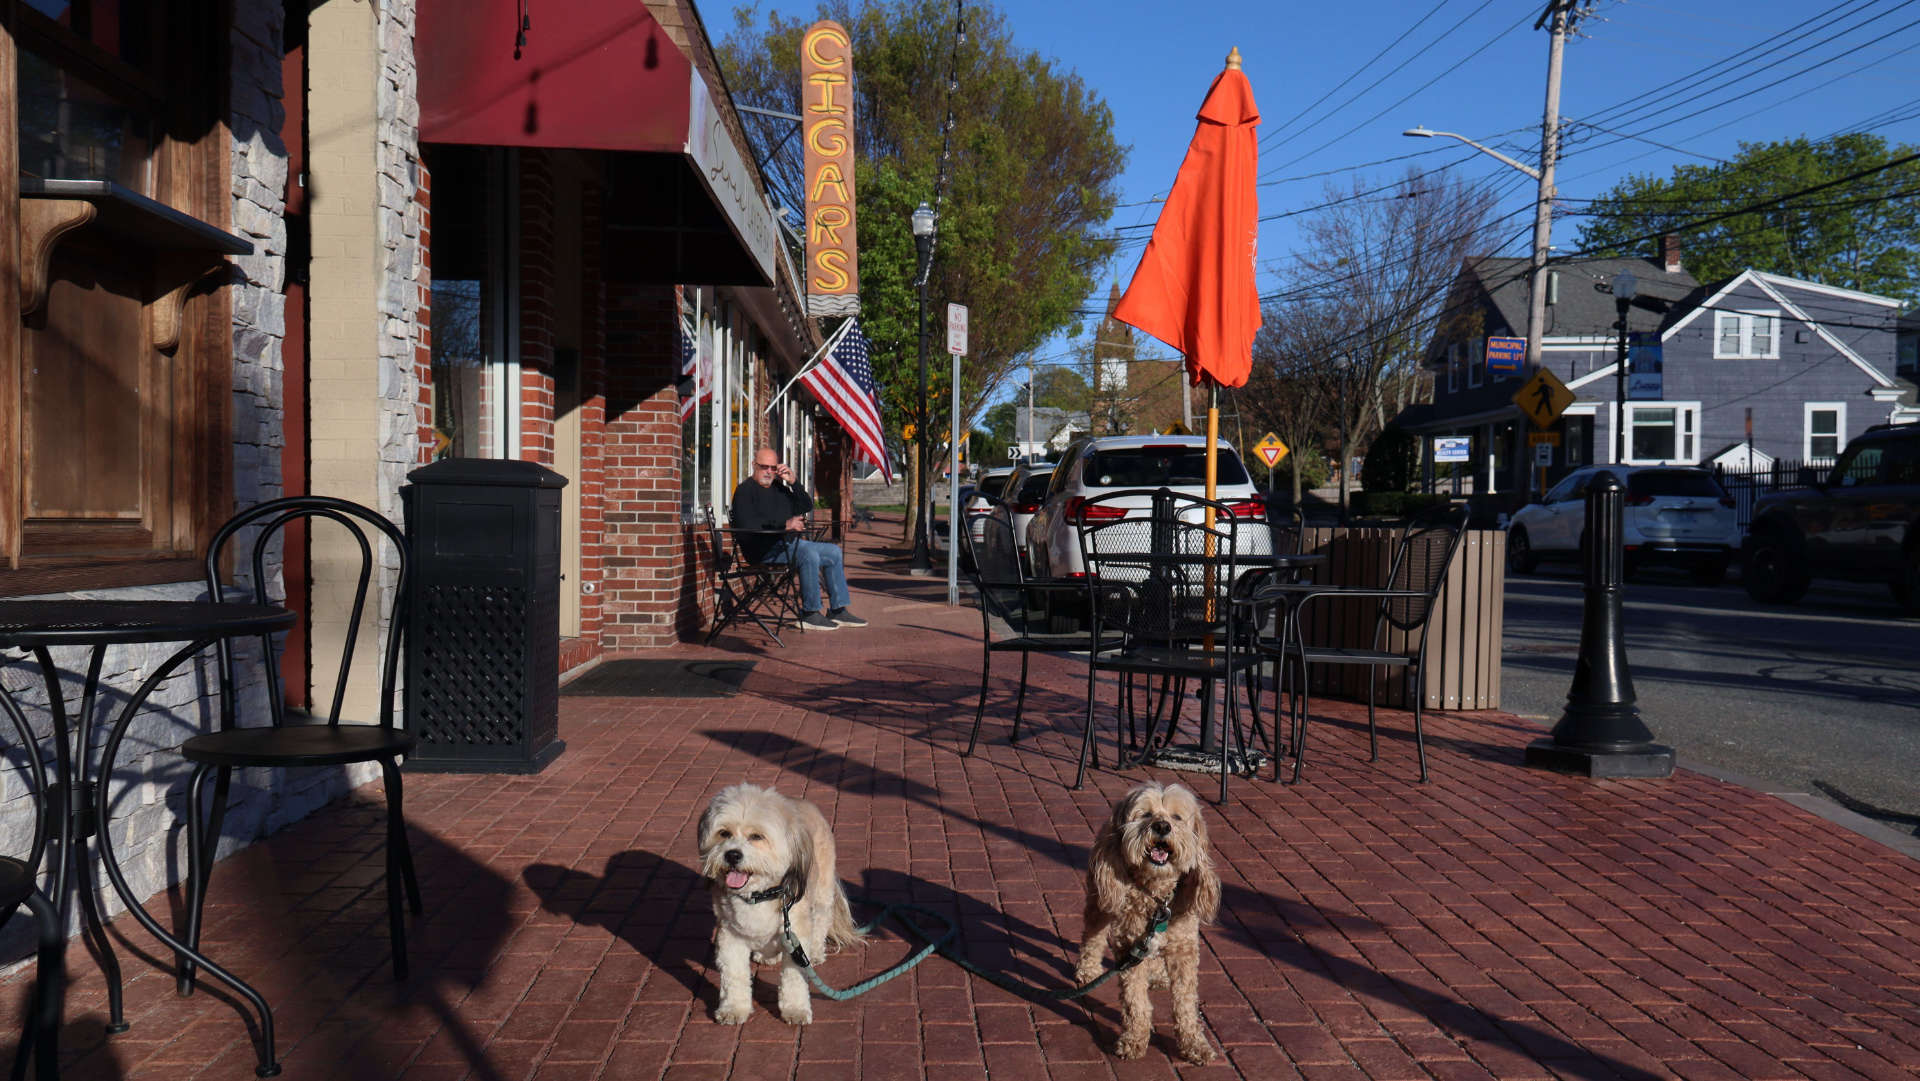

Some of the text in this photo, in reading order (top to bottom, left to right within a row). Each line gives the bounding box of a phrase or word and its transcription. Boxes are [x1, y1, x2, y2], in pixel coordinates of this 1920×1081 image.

[804, 27, 850, 293] CIGARS
[1490, 341, 1522, 350] MUNICIPAL
[1488, 351, 1512, 360] PARKING
